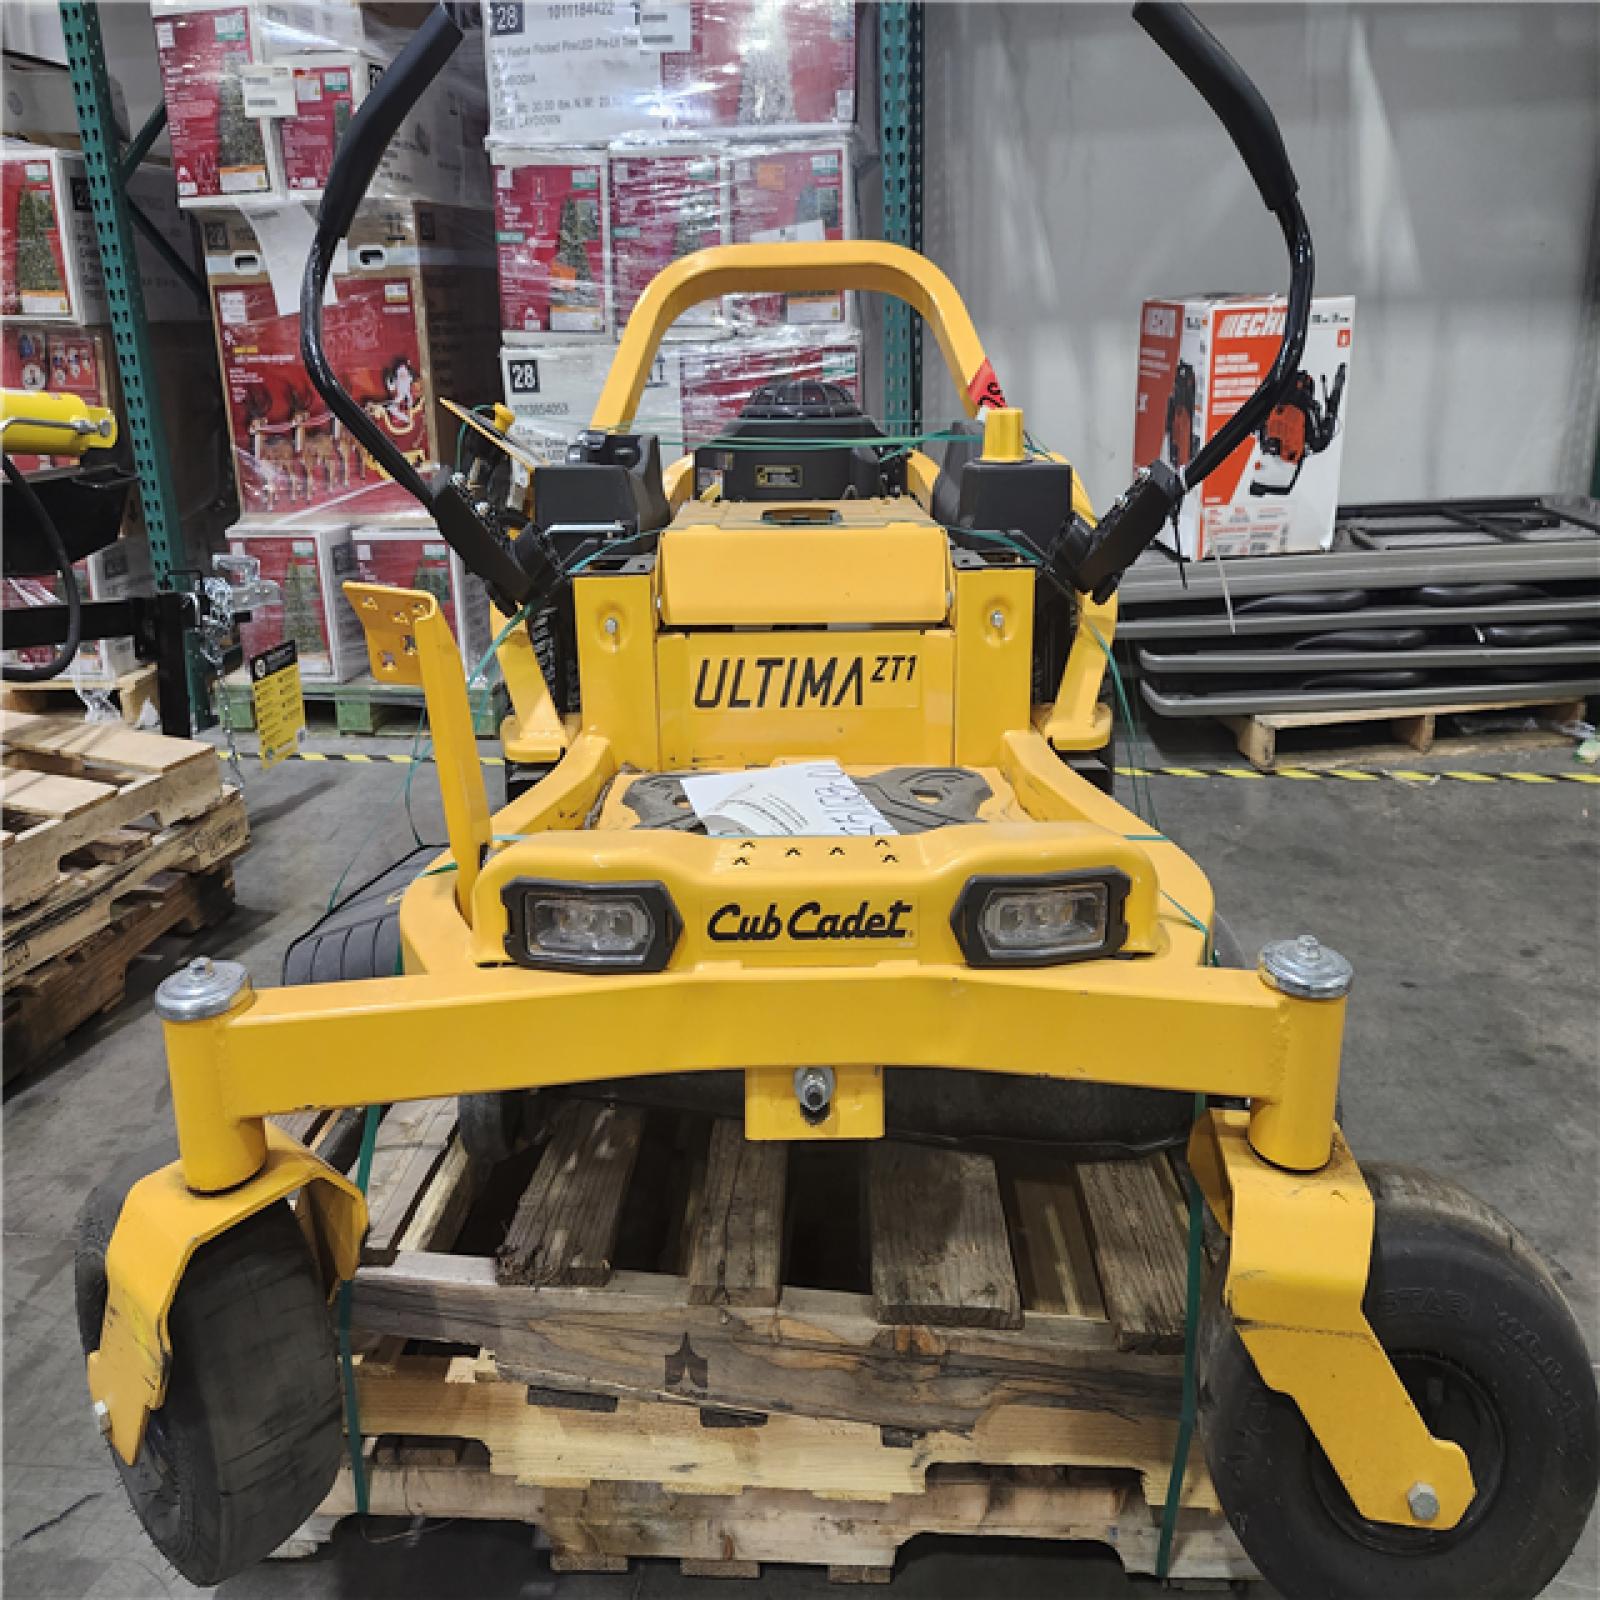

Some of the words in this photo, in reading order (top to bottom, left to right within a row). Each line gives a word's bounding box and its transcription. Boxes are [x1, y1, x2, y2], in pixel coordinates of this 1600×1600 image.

[497, 5, 518, 30] 28
[512, 364, 536, 389] 28
[693, 656, 863, 708] ULTIMA
[871, 655, 918, 682] ZT1
[707, 902, 781, 942] Cub
[788, 899, 913, 940] Cadet
